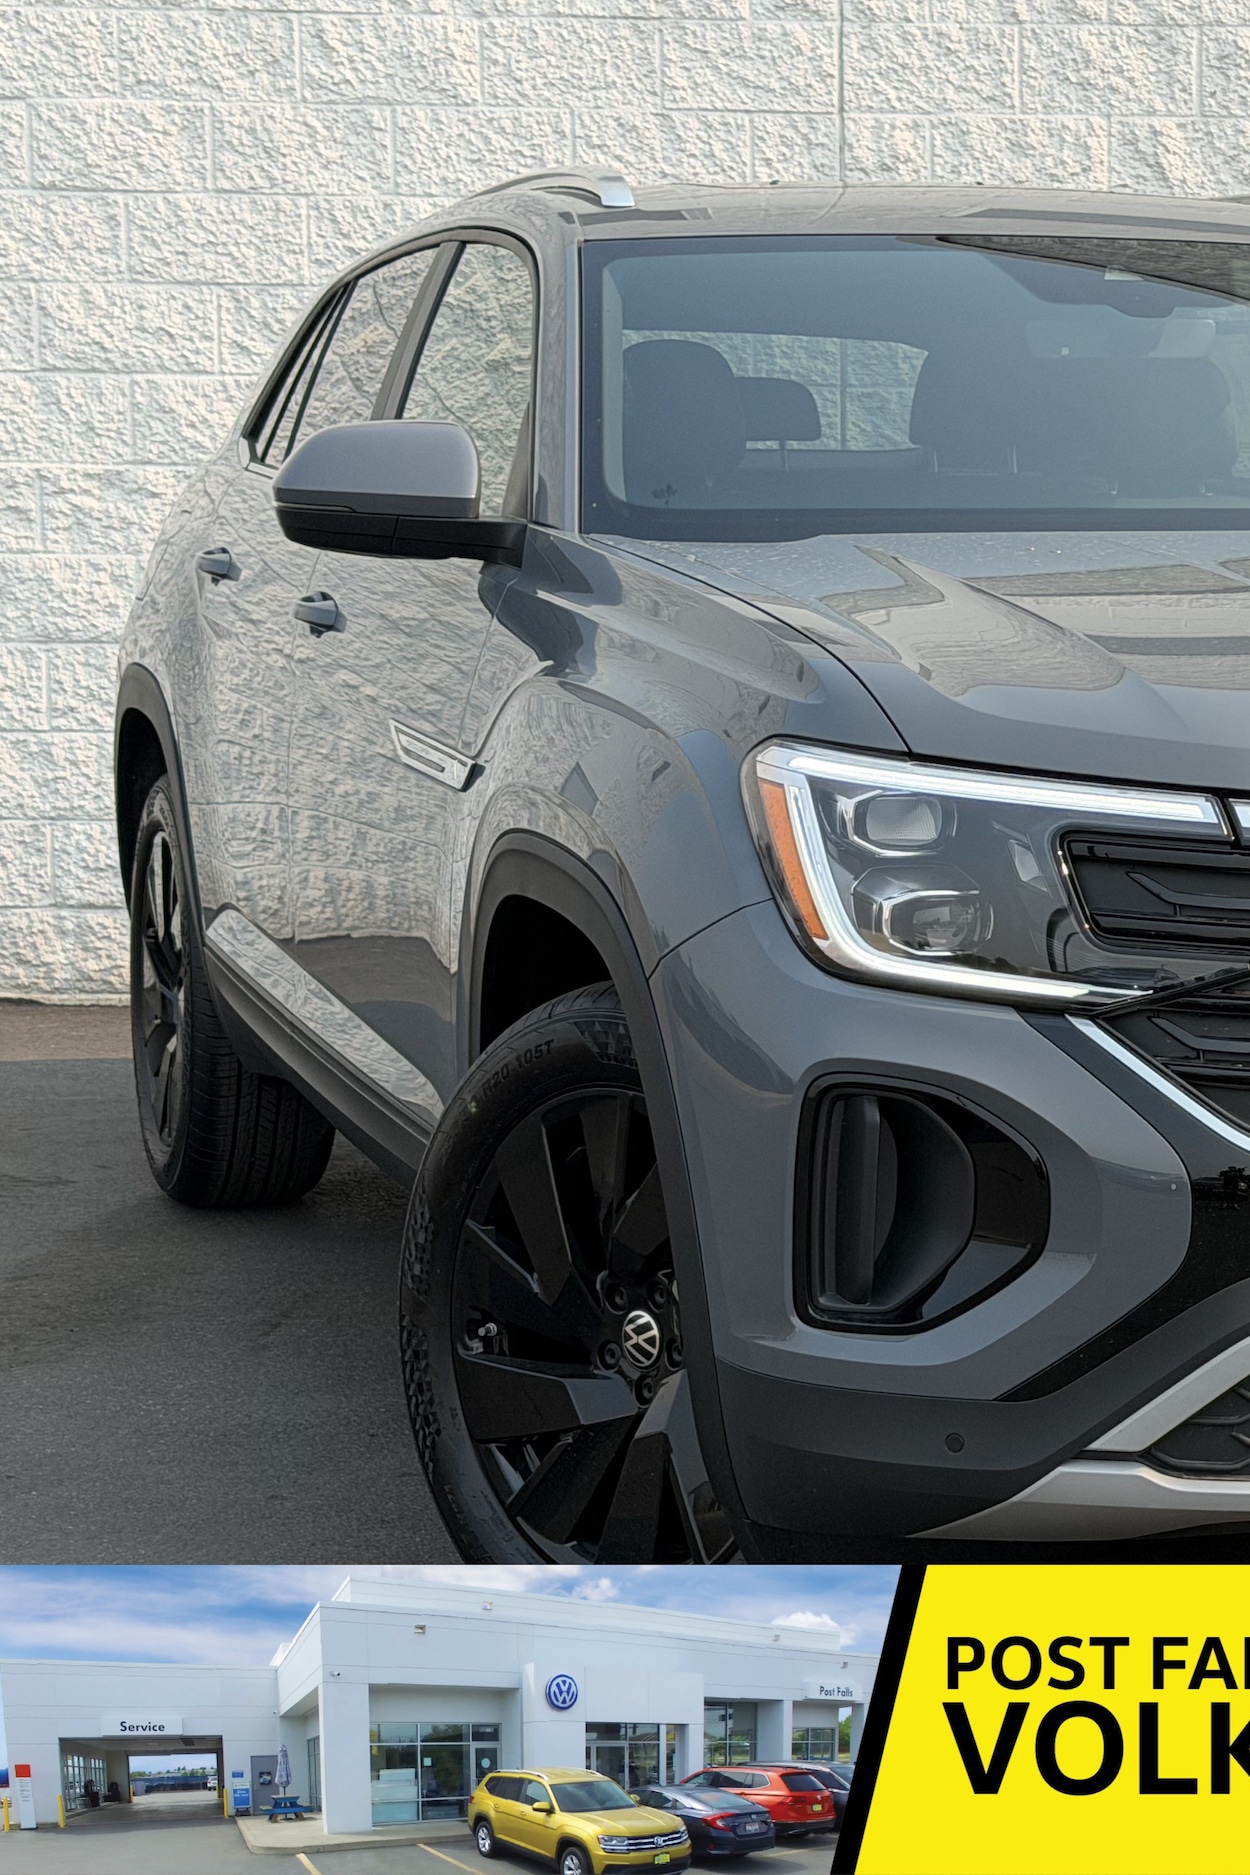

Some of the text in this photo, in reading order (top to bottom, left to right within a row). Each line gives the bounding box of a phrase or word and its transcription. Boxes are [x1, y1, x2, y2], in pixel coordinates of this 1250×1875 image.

[516, 1039, 555, 1069] 105T
[819, 1686, 853, 1697] Post Falls
[120, 1721, 165, 1732] Service
